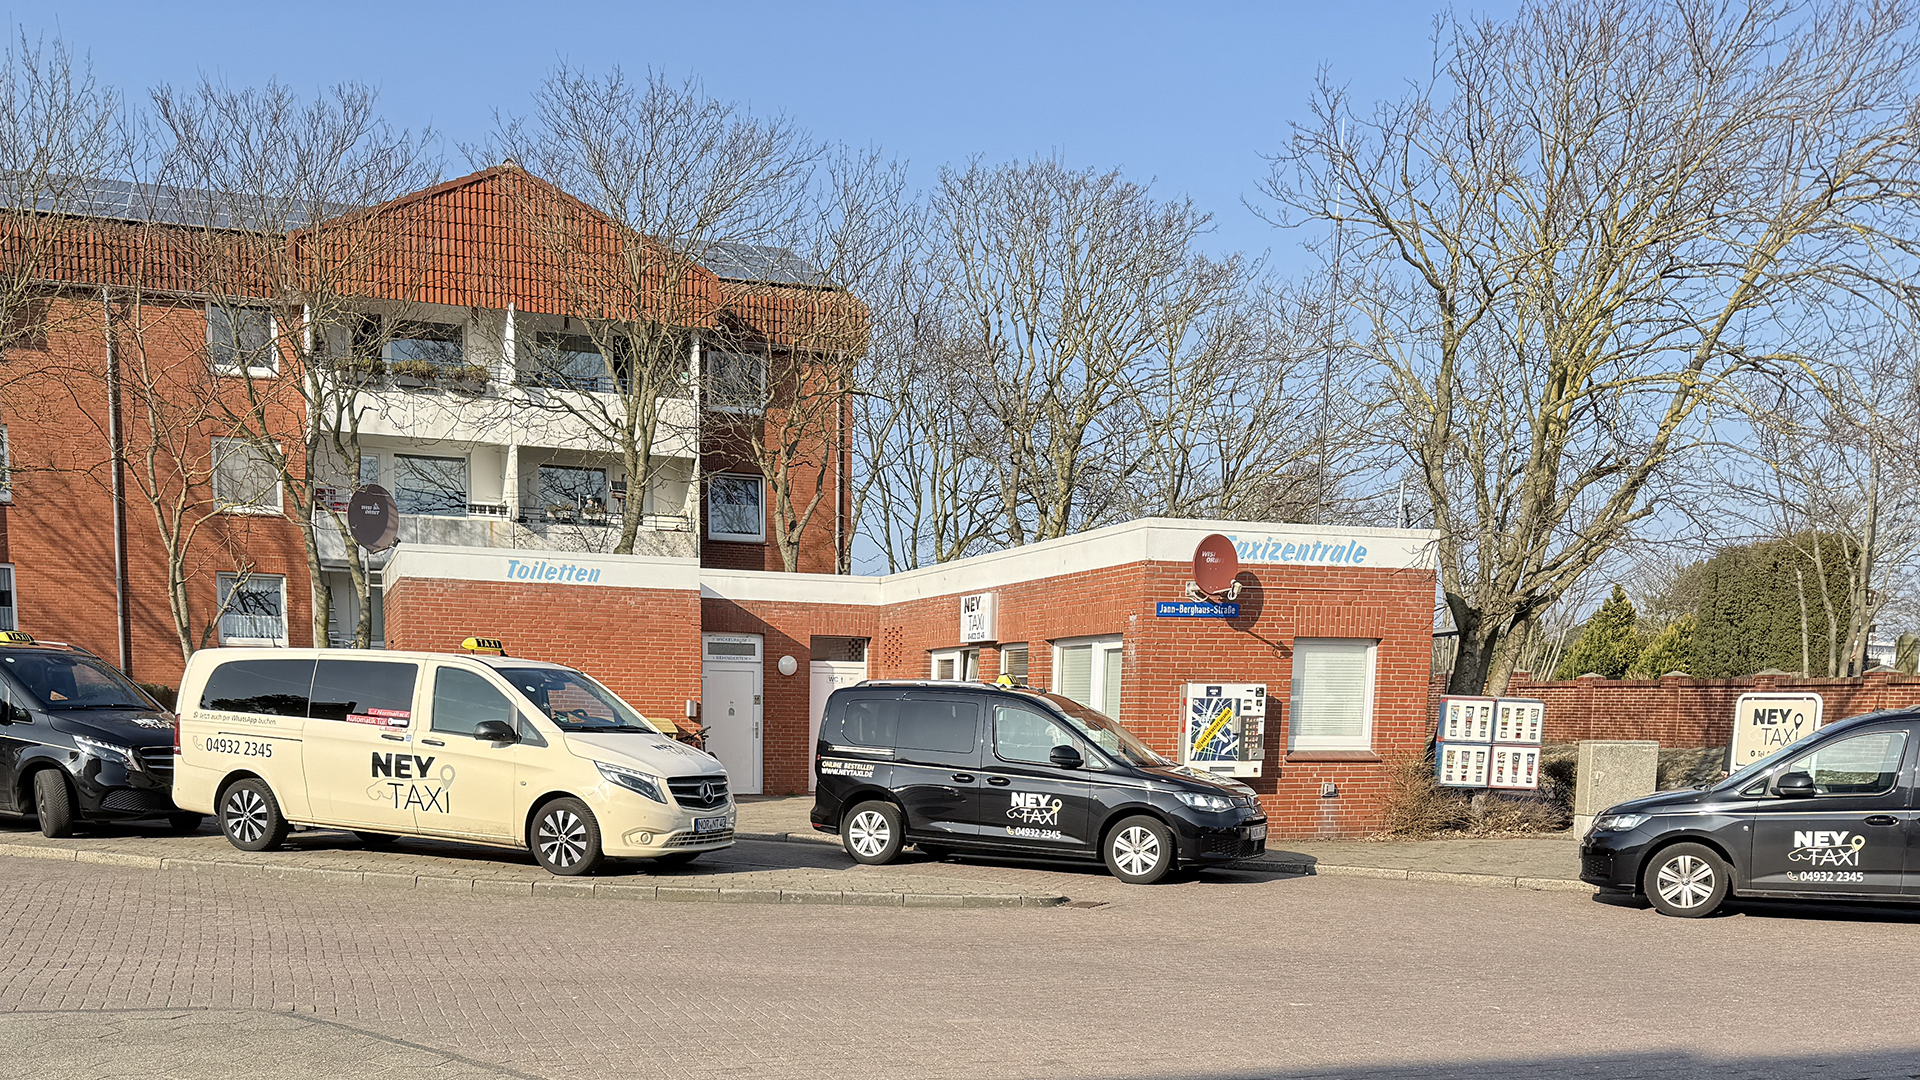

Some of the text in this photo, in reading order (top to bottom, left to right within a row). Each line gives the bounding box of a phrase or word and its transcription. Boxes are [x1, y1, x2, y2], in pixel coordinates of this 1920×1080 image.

[1226, 535, 1367, 564] axizentrale
[507, 559, 601, 583] Toiletten
[964, 595, 981, 614] NEY
[1159, 603, 1236, 616] Jann-Berghaus-Straße
[968, 613, 985, 631] TAXI
[477, 638, 500, 648] TAXI
[231, 715, 258, 724] WhatsApp
[1752, 708, 1793, 726] NEY
[1761, 727, 1799, 746] TAXI
[206, 737, 273, 758] 04932 2345
[371, 751, 436, 779] NEY
[821, 760, 875, 771] ONLINE BESTELLEN
[821, 767, 873, 778] WWW.NEYTAXI.DE
[387, 782, 450, 814] TAXI
[1011, 791, 1051, 807] NEY
[1020, 808, 1058, 826] TAXI
[1015, 826, 1062, 840] 04932 2345
[1793, 830, 1850, 848] NEY
[1806, 848, 1859, 867] TAXI
[1800, 871, 1864, 882] 04932 2345
